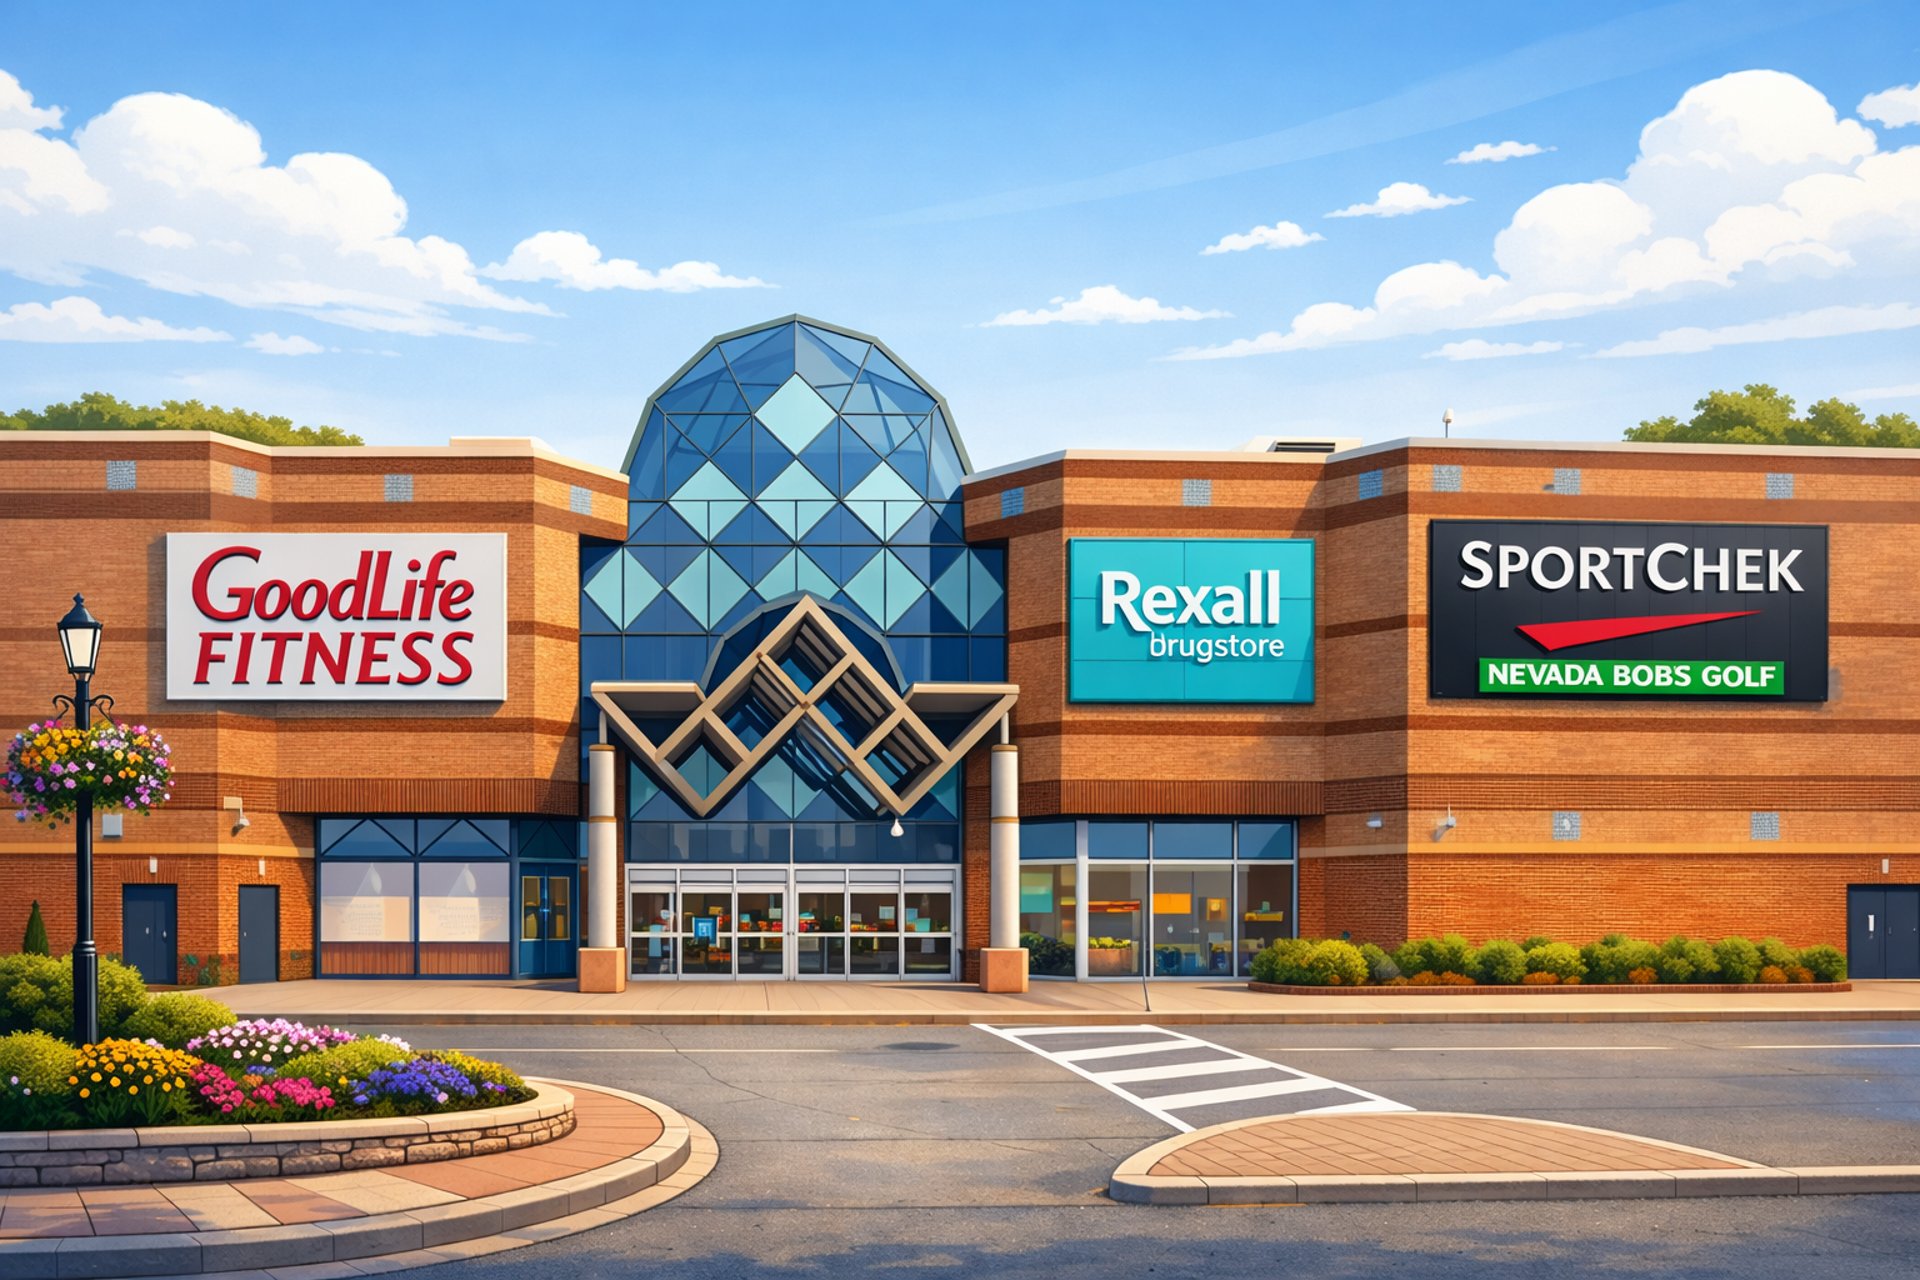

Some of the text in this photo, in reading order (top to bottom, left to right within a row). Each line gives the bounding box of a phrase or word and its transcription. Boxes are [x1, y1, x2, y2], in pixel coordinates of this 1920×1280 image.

[192, 546, 475, 620] GoodLife
[1460, 540, 1806, 592] SPORTCHEK
[1100, 569, 1281, 632] Rexall
[193, 631, 475, 685] FITNESS
[1487, 663, 1605, 686] NEVADA
[1701, 665, 1777, 688] GOLF
